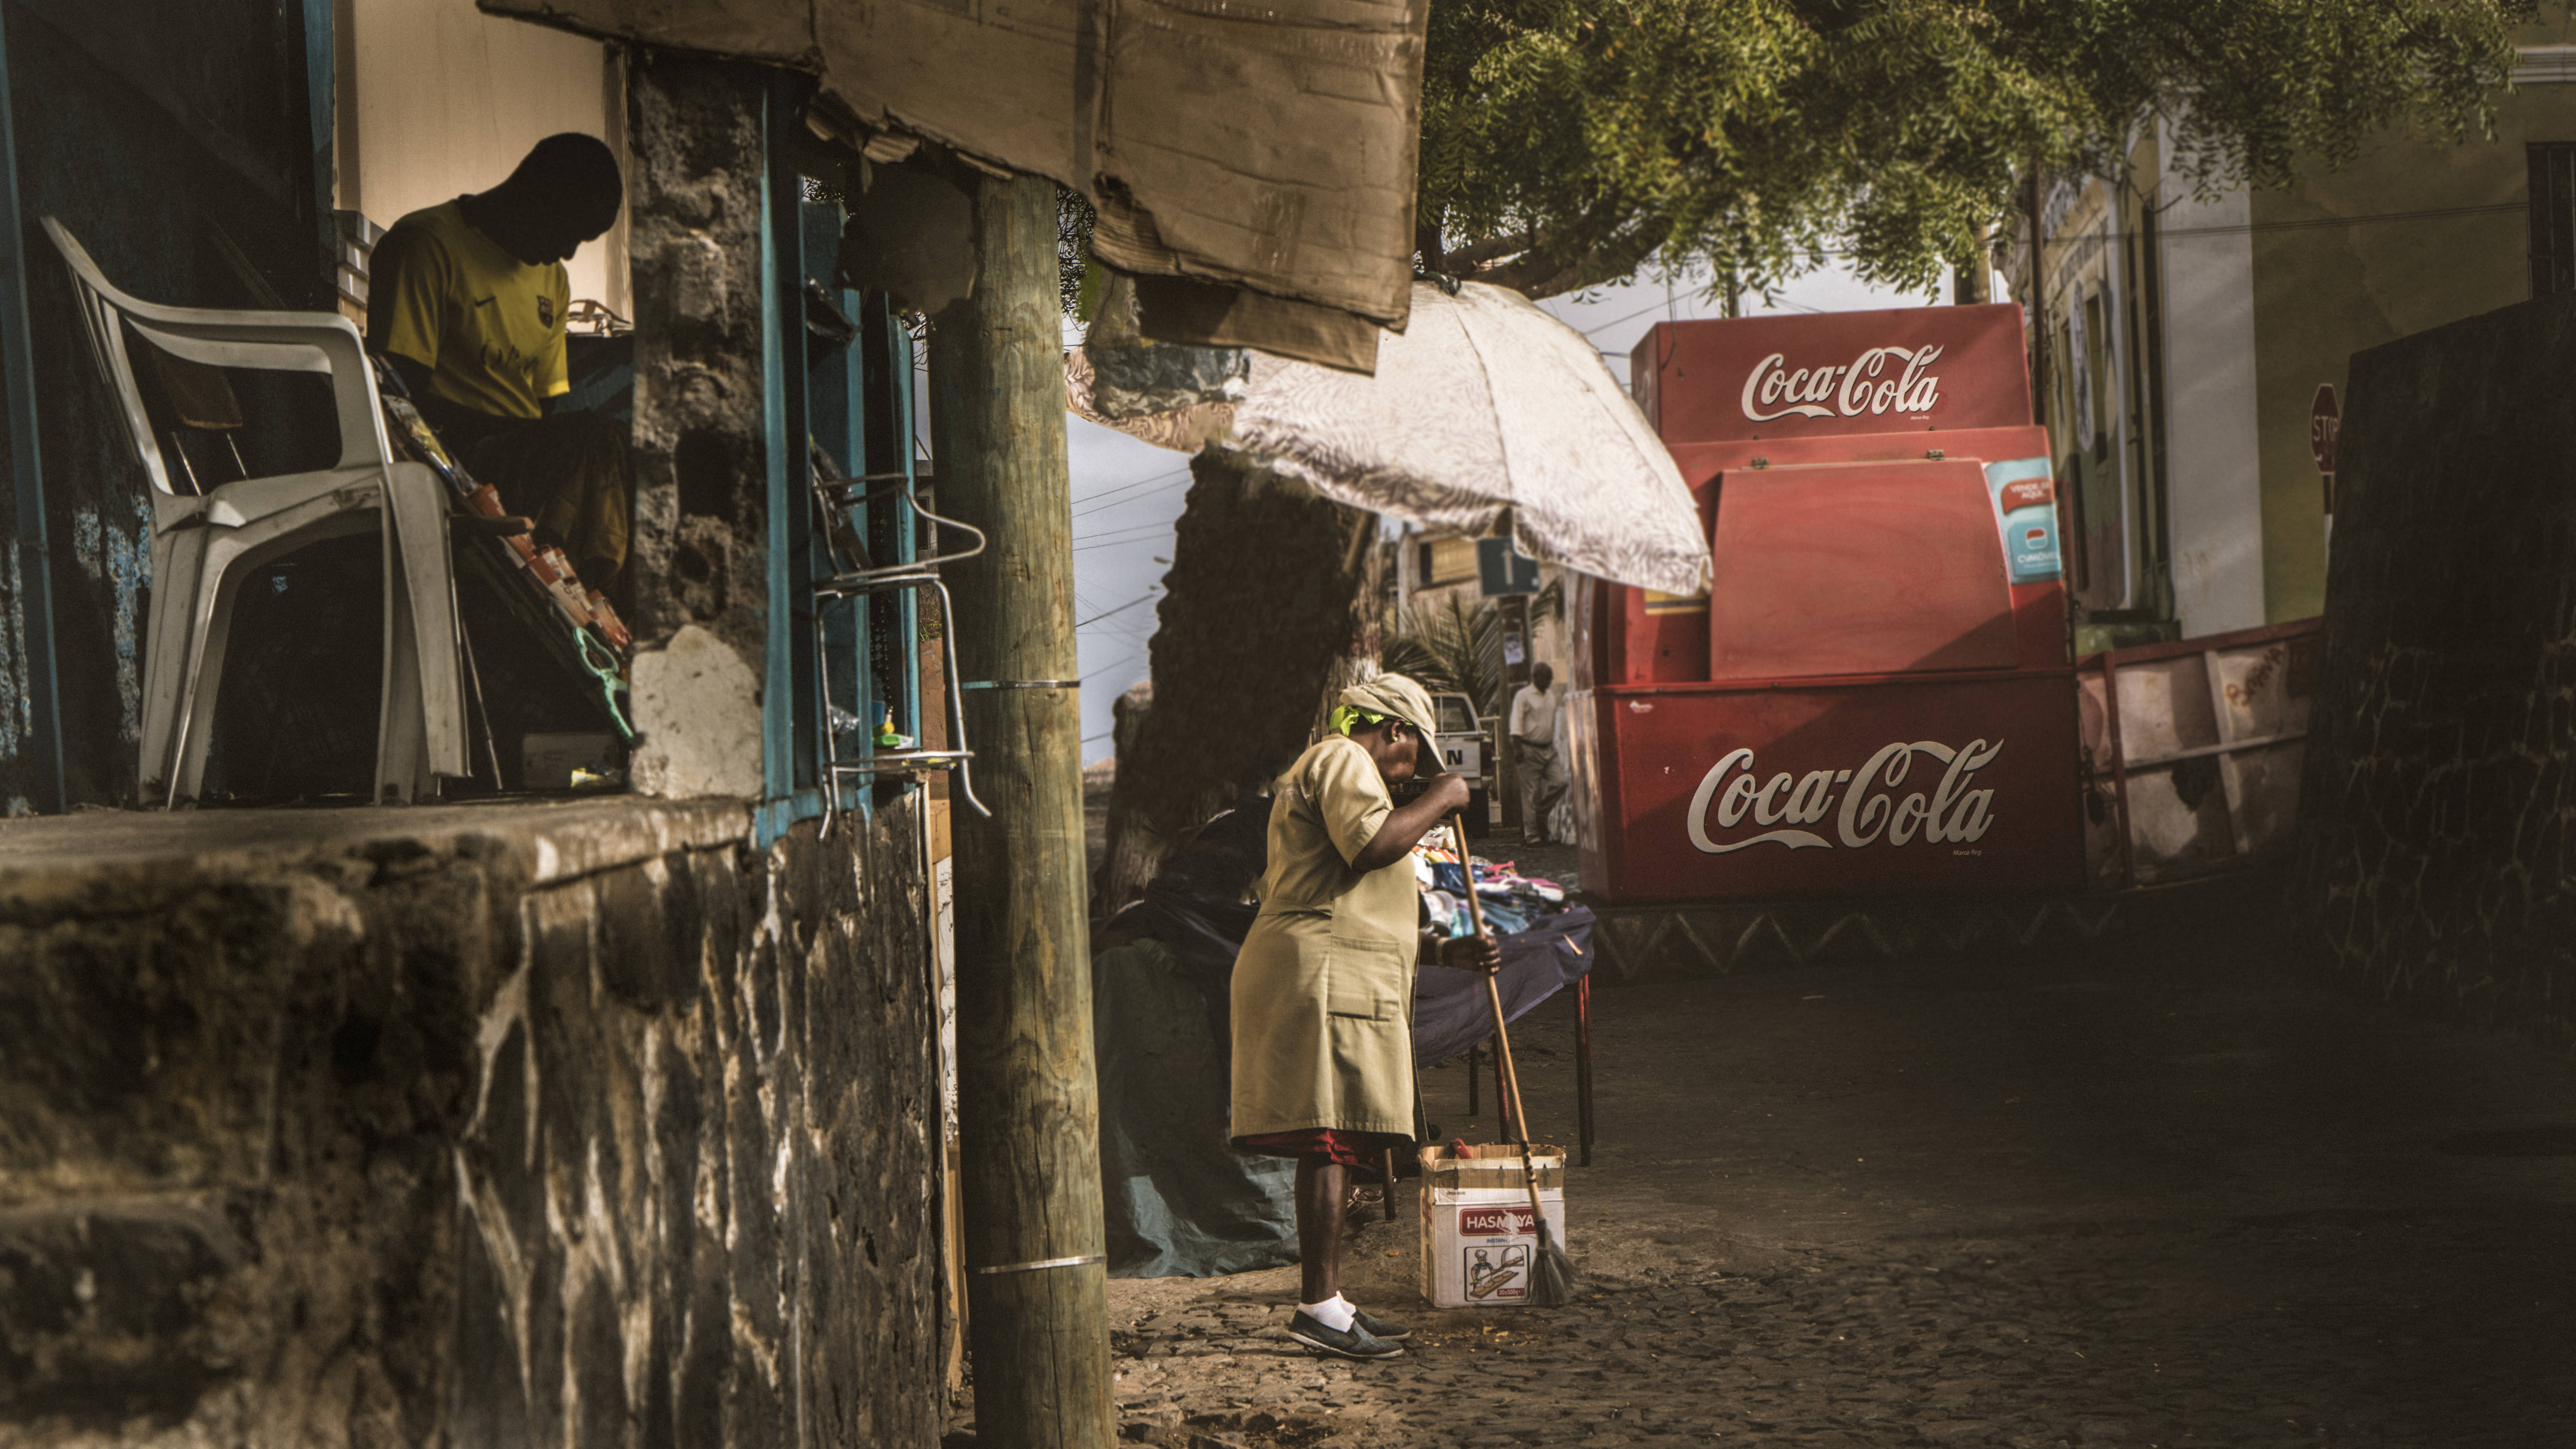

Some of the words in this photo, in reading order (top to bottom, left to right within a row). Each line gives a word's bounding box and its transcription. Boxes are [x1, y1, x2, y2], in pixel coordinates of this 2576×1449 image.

[1741, 345, 1944, 421] Coca-Cola
[2313, 415, 2339, 442] STOP
[1687, 738, 2004, 853] Coca-Cola
[1467, 1214, 1535, 1229] HASMYA
